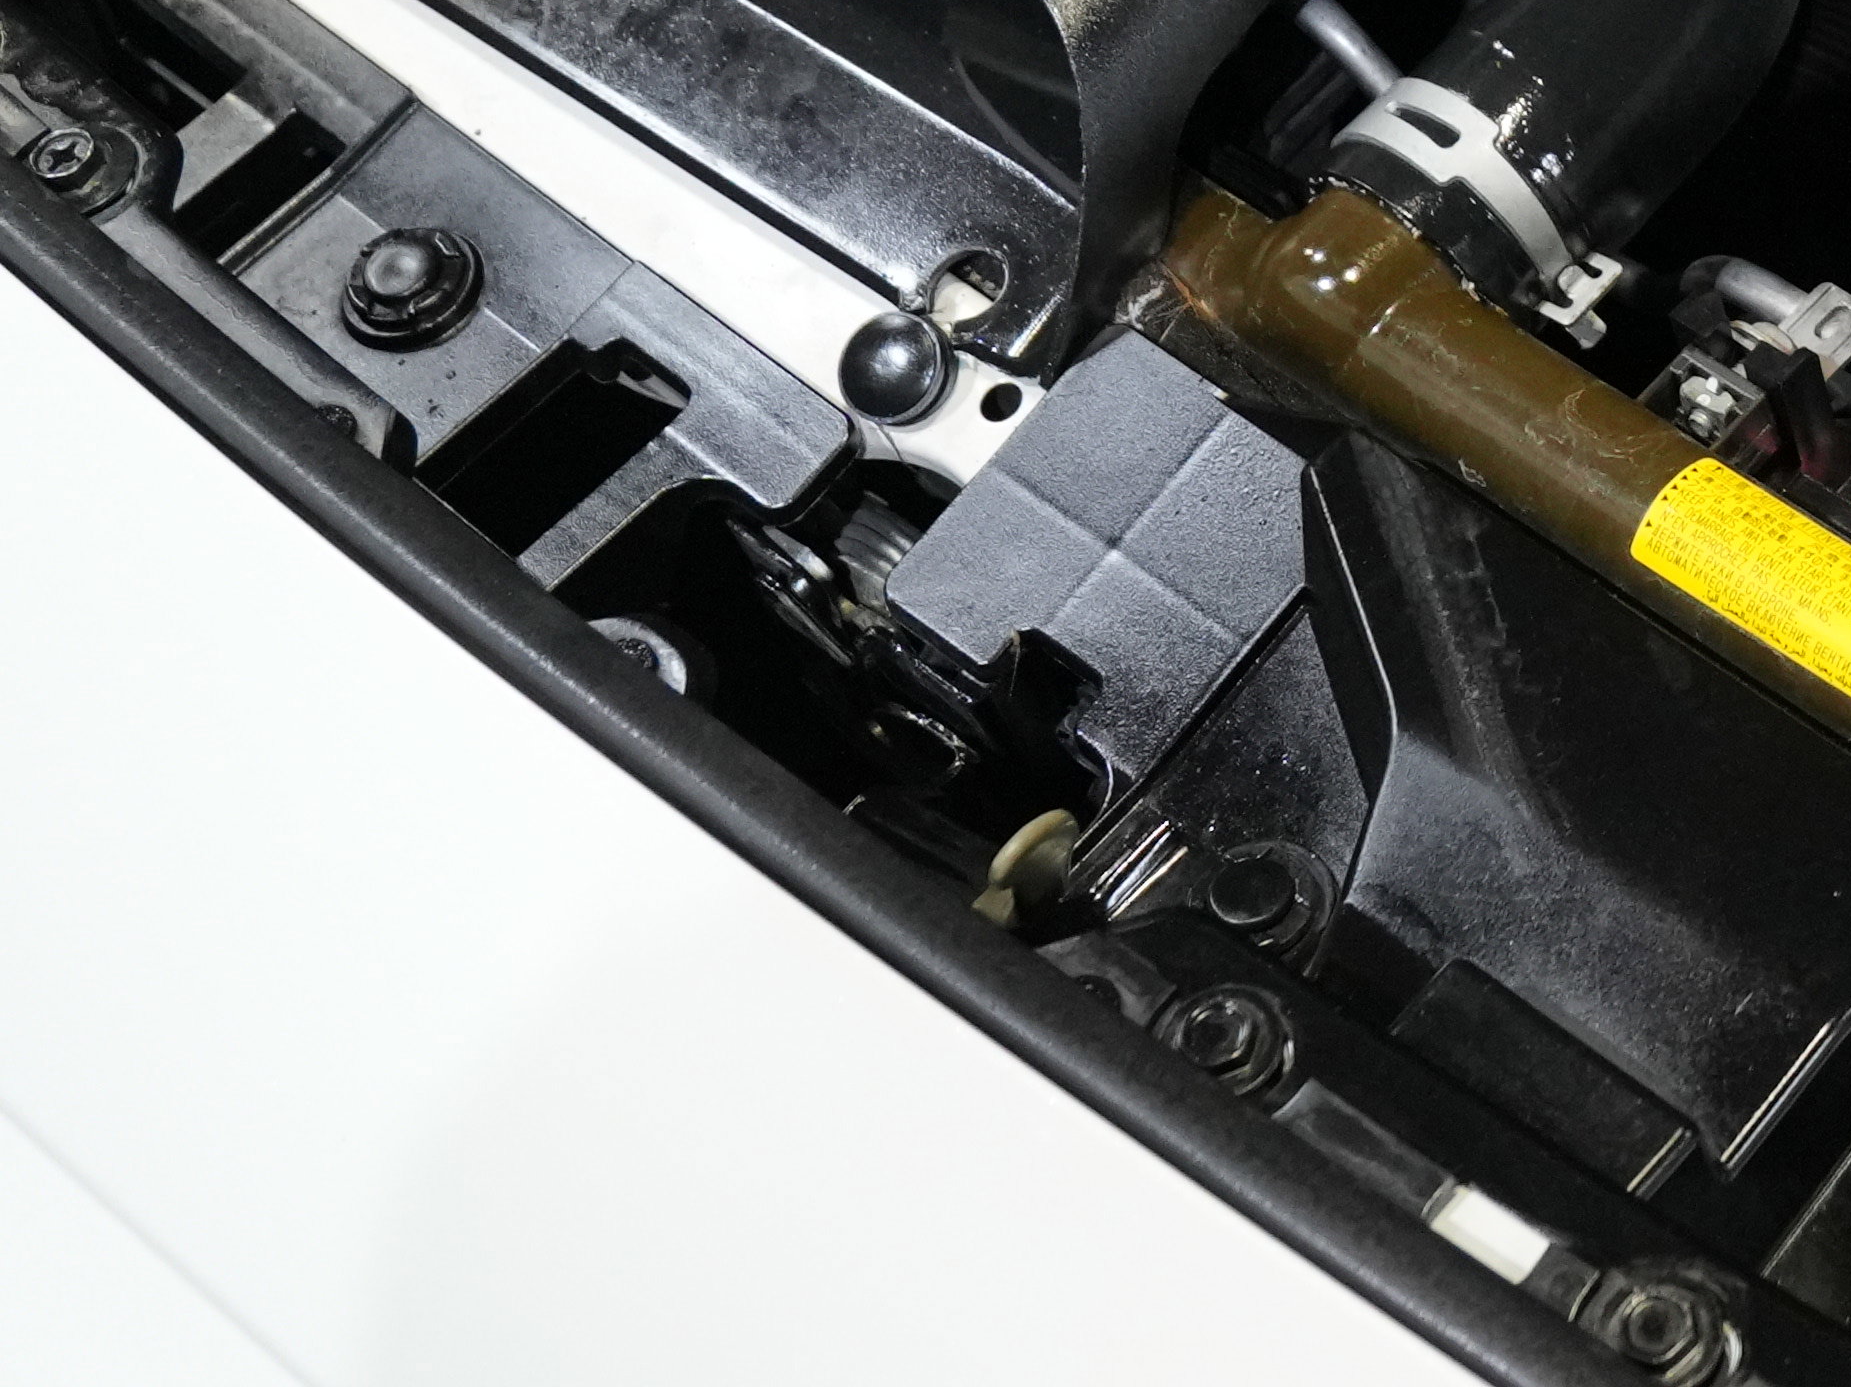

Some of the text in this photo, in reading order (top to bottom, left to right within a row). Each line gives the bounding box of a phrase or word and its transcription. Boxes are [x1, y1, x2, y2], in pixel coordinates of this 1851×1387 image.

[1666, 496, 1684, 511] LE
[1737, 540, 1756, 556] DU
[1754, 551, 1822, 598] VENTILATEUR
[1676, 485, 1706, 508] KEEP
[1704, 503, 1740, 529] HANDS
[1772, 545, 1797, 565] FAN
[1795, 560, 1836, 590] STARTS
[1688, 527, 1748, 569] APPROCHEZ
[1747, 564, 1773, 585] PAS
[1771, 579, 1798, 601] LES
